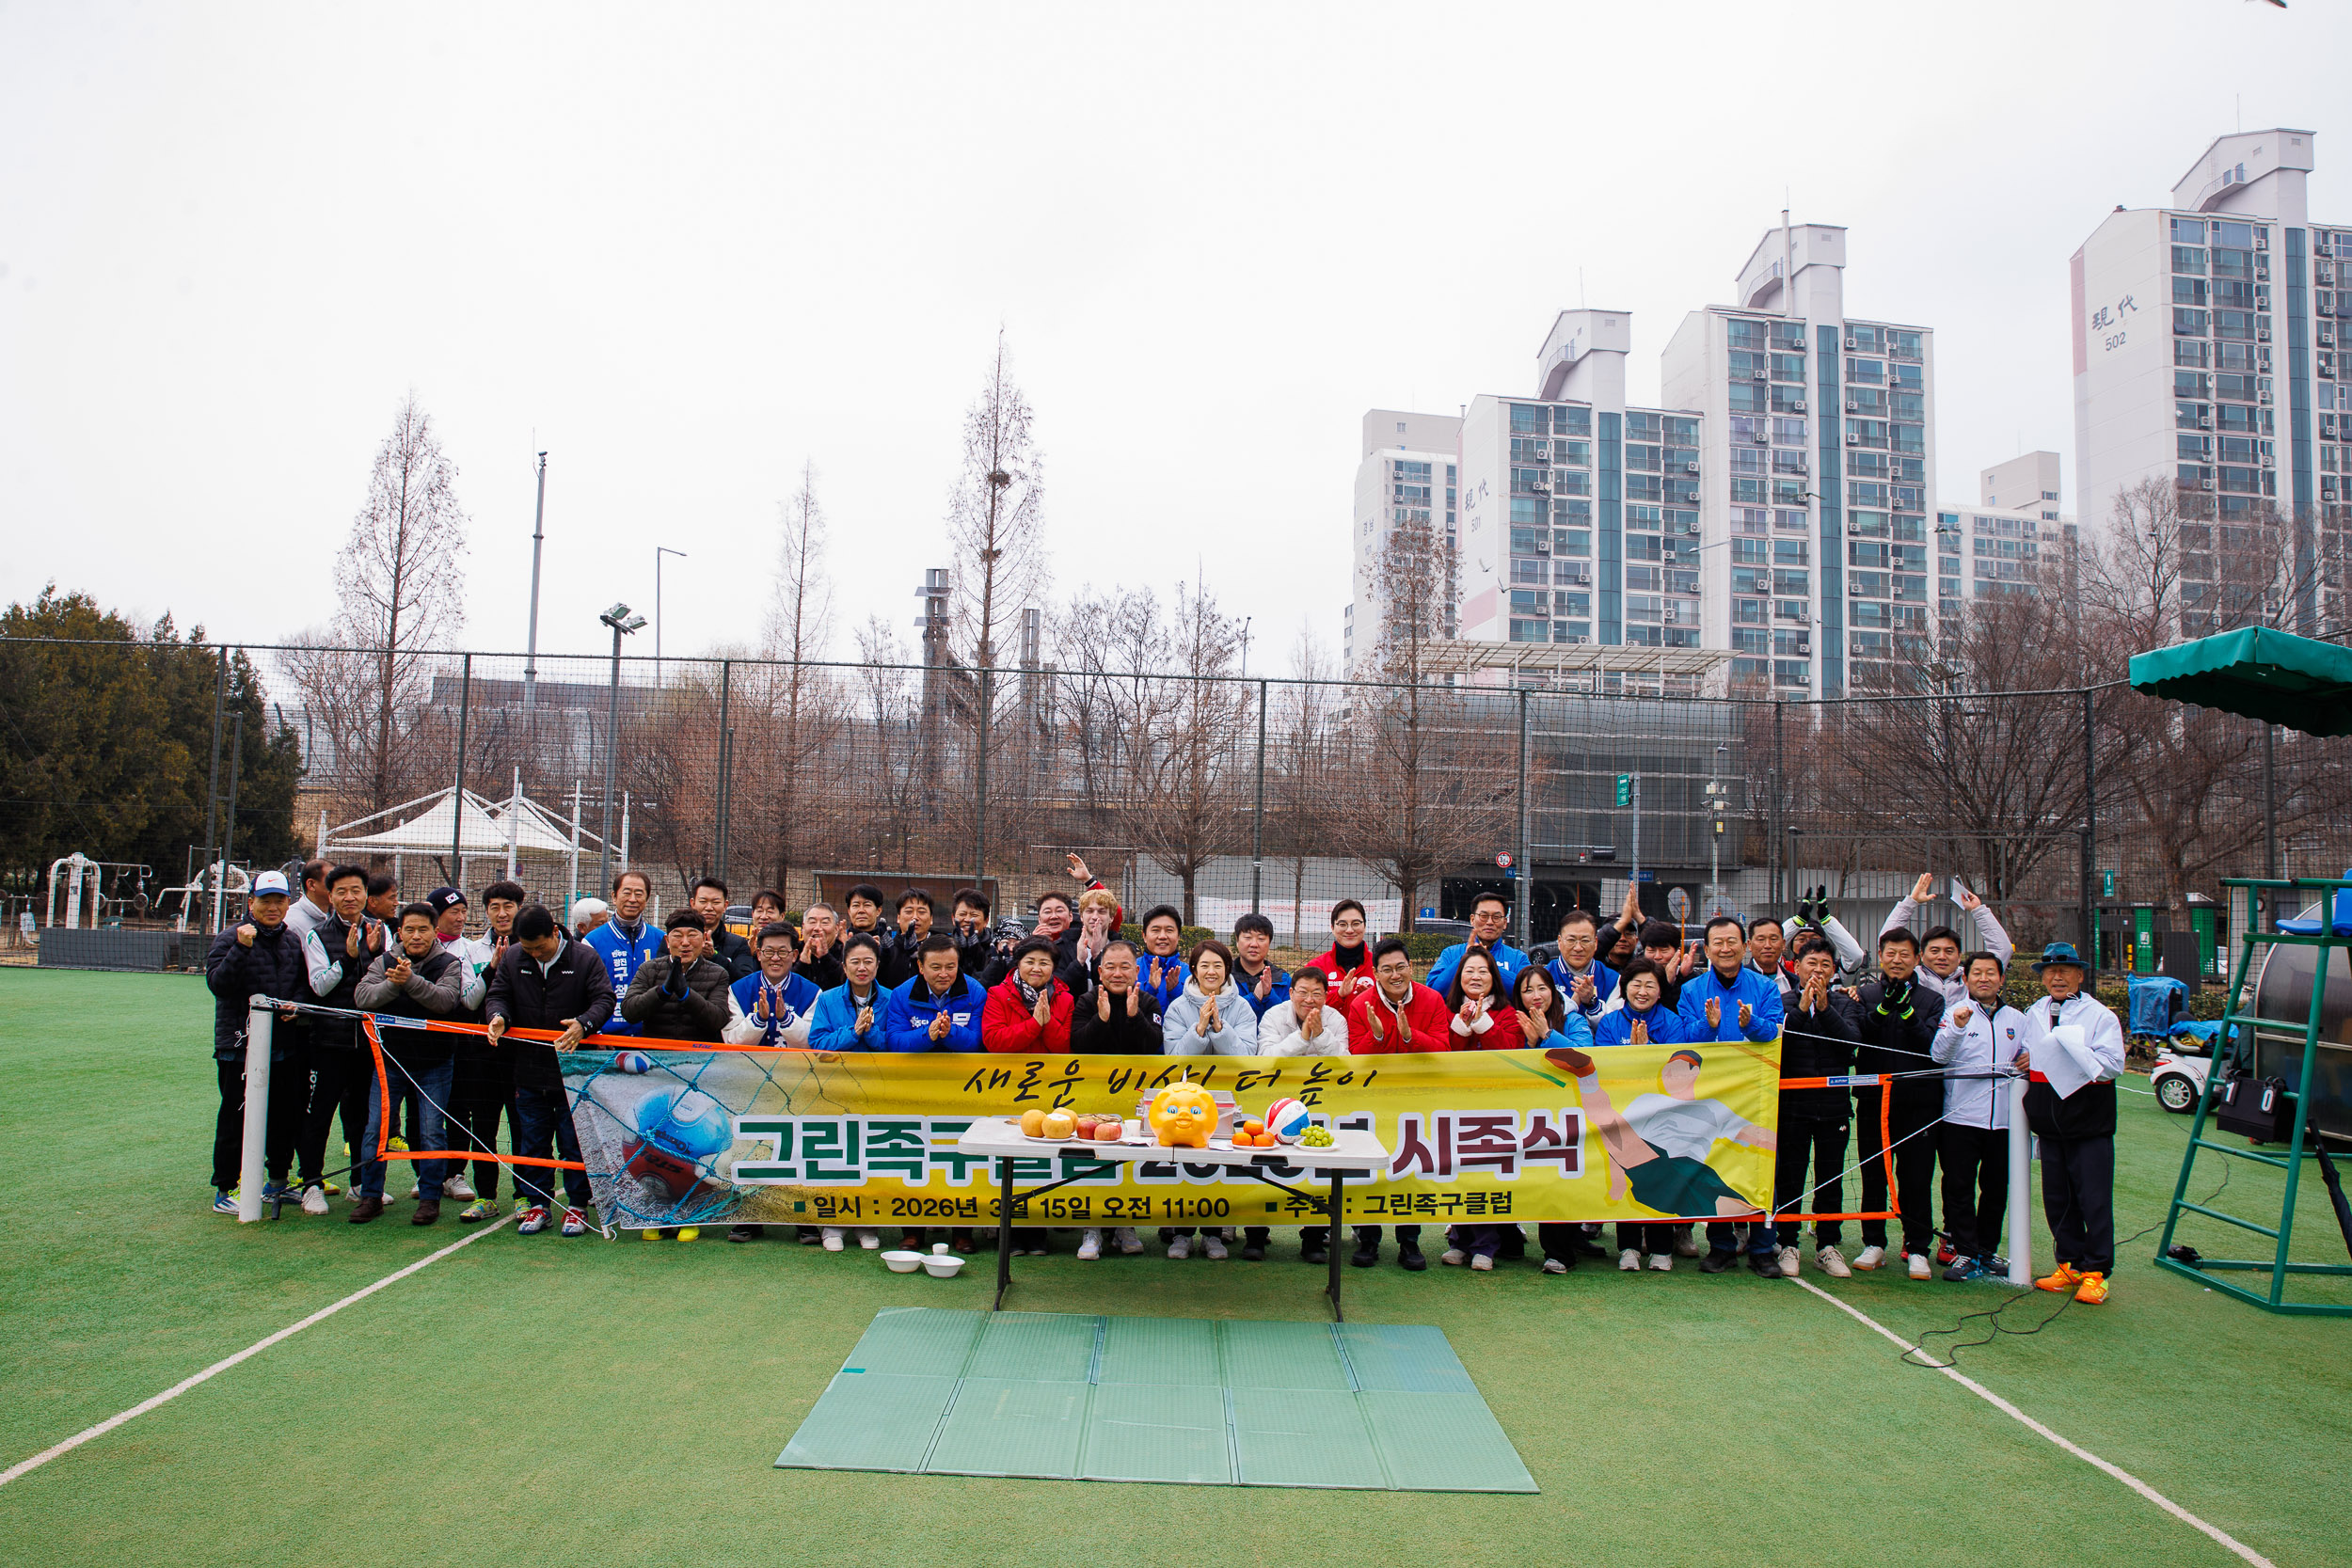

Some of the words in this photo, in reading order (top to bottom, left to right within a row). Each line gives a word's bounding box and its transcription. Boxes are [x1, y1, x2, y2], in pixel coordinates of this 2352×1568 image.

[2091, 294, 2138, 331] 現代
[2105, 331, 2126, 352] 502
[644, 949, 651, 962] 1
[963, 1059, 1085, 1110] 새로운
[1235, 1069, 1281, 1091] 더
[1300, 1062, 1377, 1107] 높이
[2225, 1082, 2235, 1102] 1
[2261, 1089, 2274, 1112] 0
[1392, 1114, 1580, 1176] 시족식
[814, 1196, 862, 1219] 일시
[891, 1196, 978, 1219] 2026년
[1041, 1196, 1091, 1220] 15일
[1102, 1196, 1152, 1220] 오전
[1162, 1197, 1231, 1219] 11:00
[1363, 1190, 1512, 1216] 그린족구클럽
